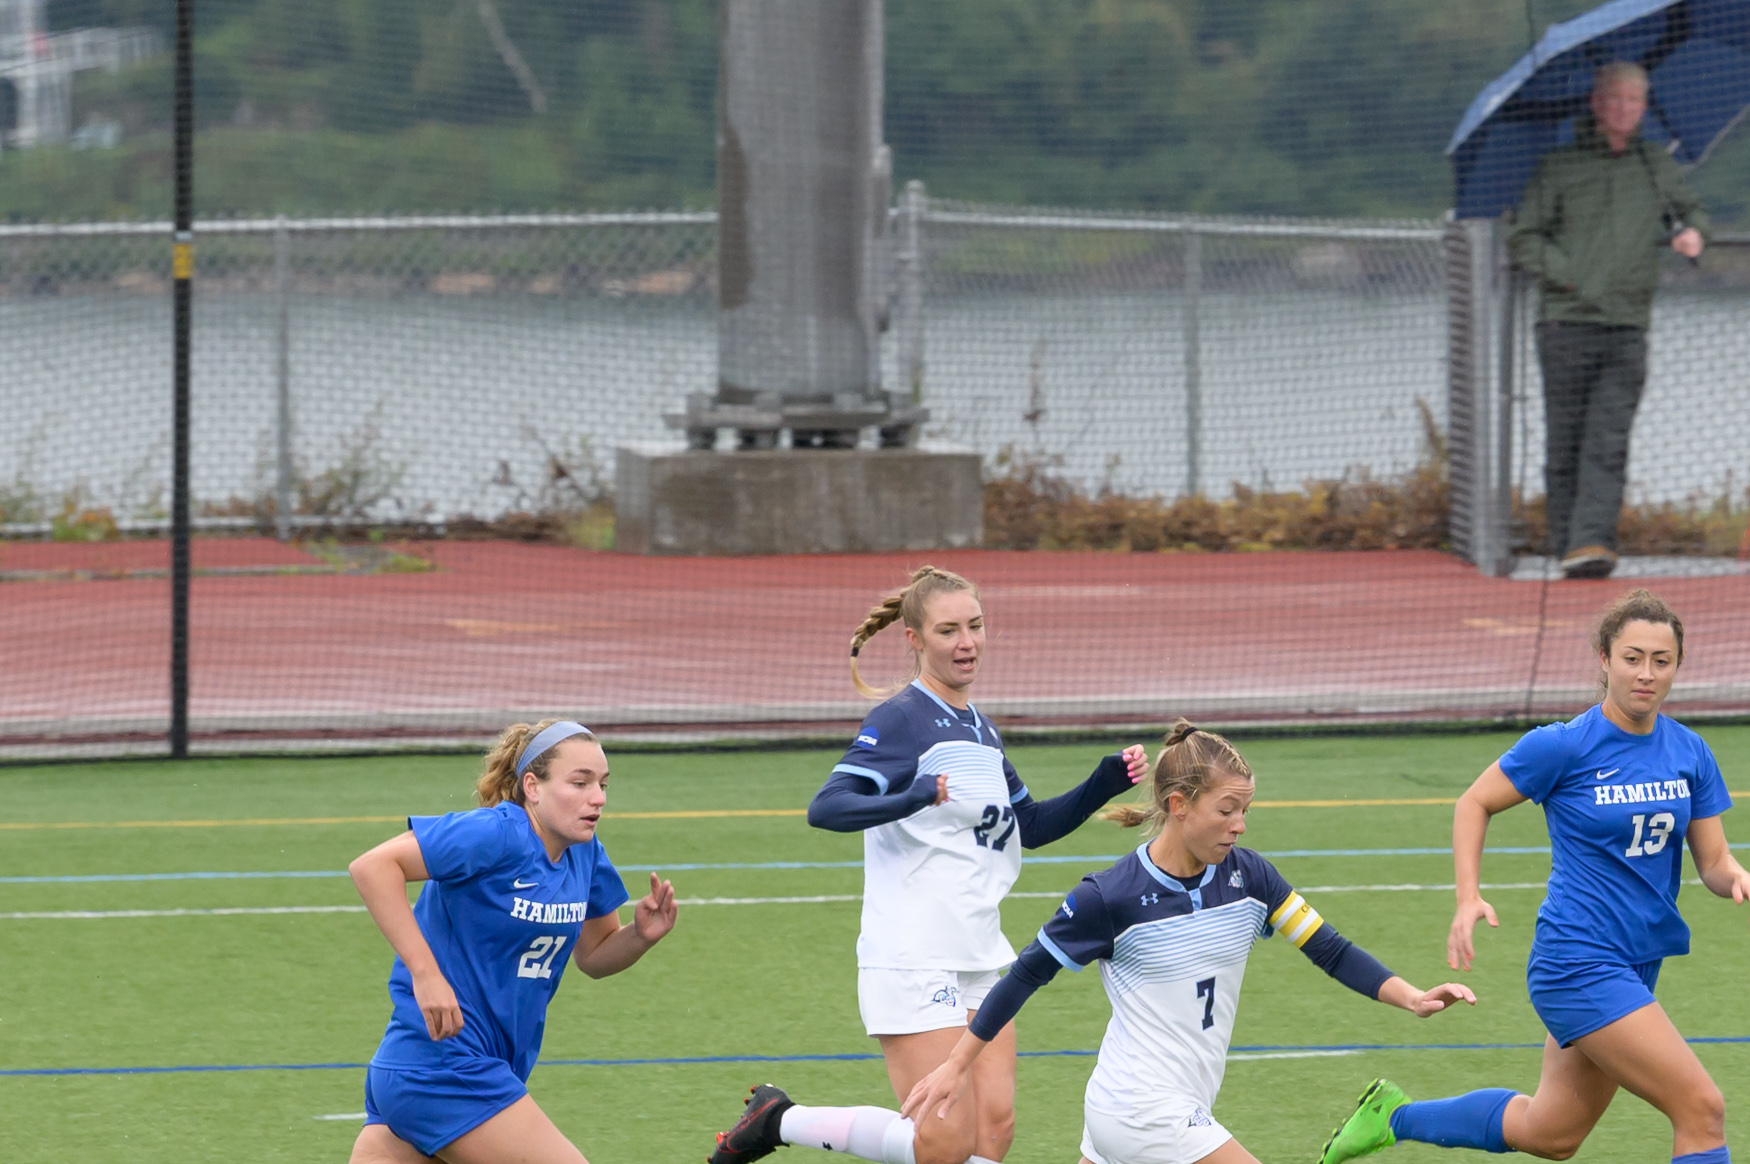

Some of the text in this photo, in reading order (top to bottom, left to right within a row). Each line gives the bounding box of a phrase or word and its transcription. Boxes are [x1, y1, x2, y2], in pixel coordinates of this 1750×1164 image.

[973, 804, 1016, 852] 27
[1625, 812, 1675, 857] 13
[510, 896, 588, 924] HAMILTO
[517, 935, 568, 979] 21
[1196, 976, 1216, 1031] 7
